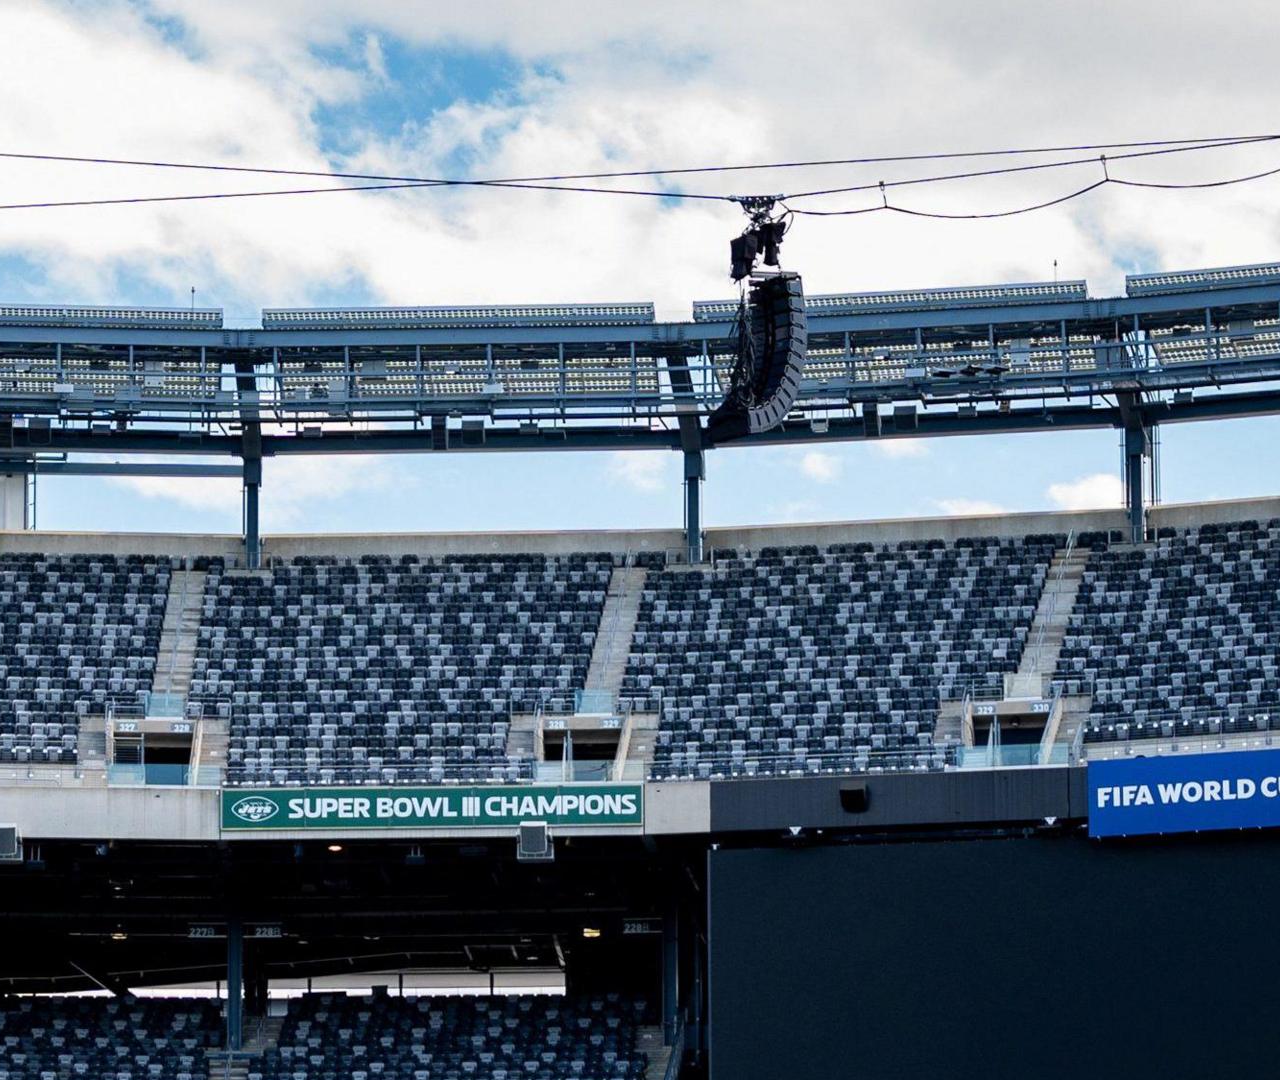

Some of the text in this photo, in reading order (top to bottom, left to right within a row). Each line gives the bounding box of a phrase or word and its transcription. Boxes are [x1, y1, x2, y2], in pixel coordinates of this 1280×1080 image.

[288, 794, 637, 819] SUPER BOWL III CHAMPIONS
[1097, 784, 1155, 808] FIFA
[1157, 778, 1257, 804] WORLD
